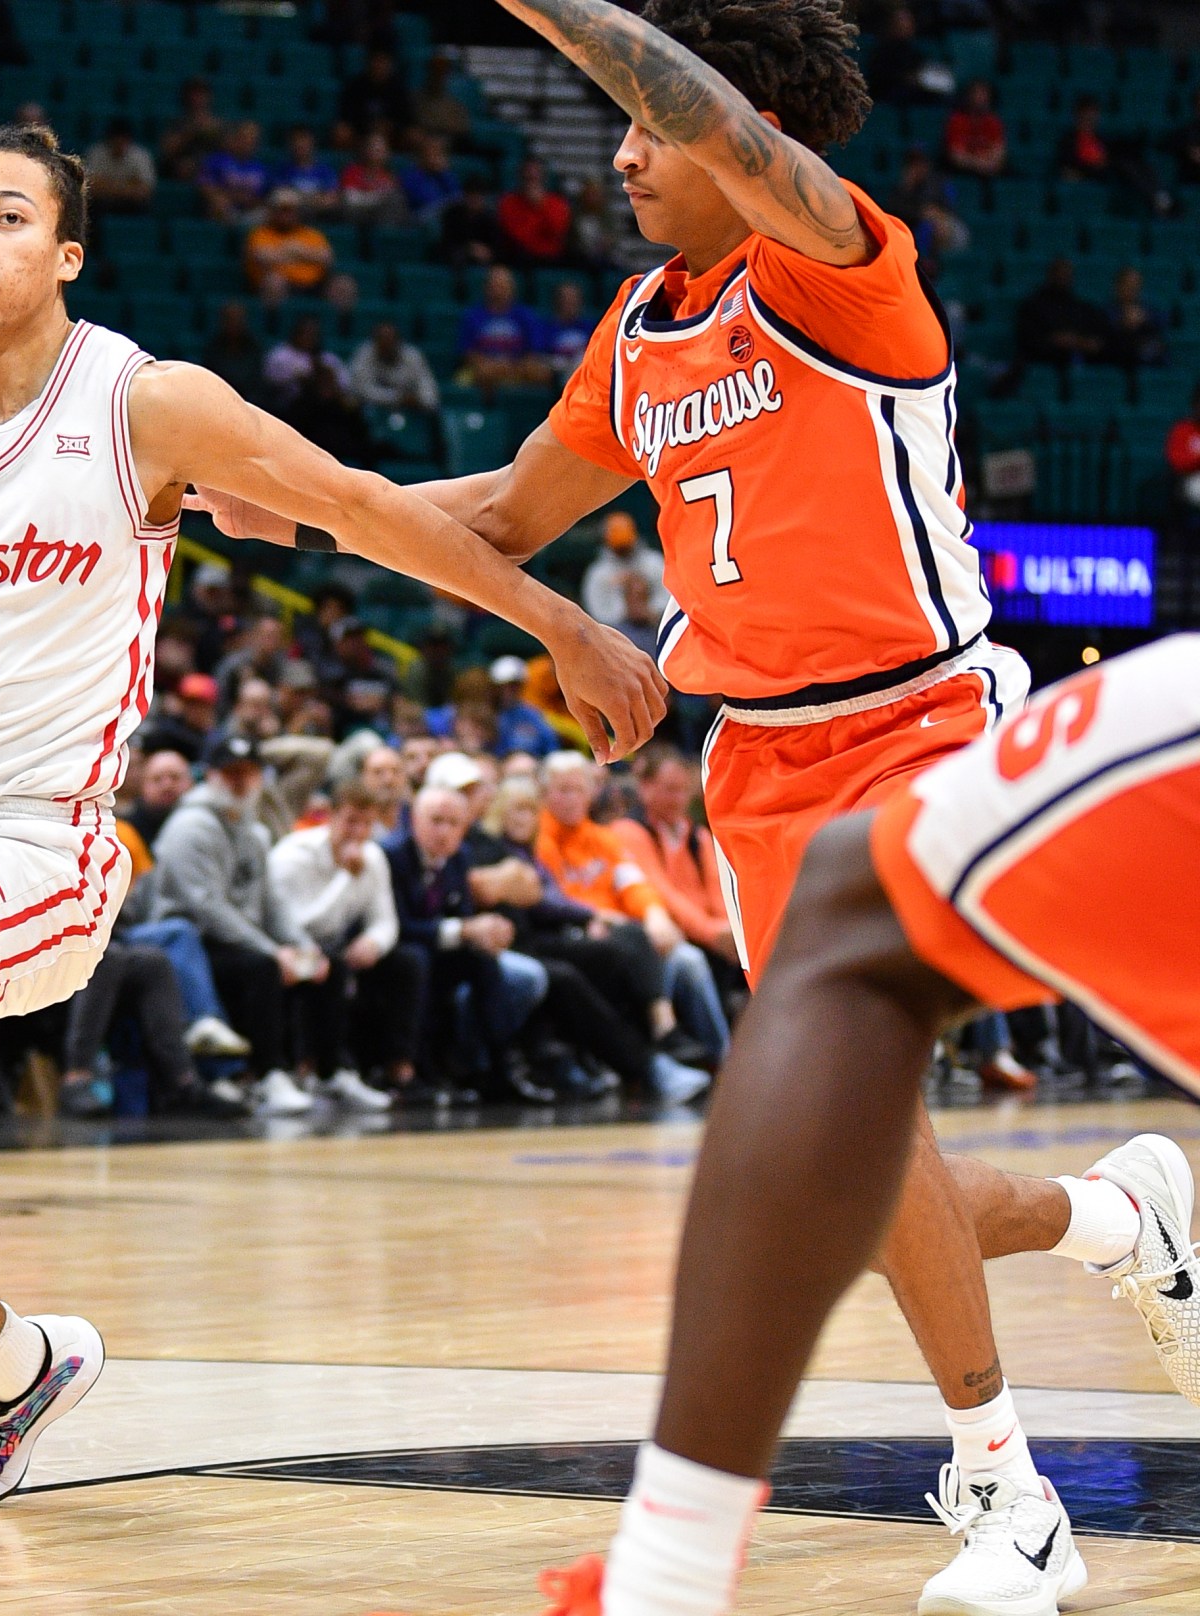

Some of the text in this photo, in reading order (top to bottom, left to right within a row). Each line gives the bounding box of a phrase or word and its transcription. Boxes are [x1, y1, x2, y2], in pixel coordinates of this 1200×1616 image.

[631, 359, 783, 478] Syracuse
[676, 466, 744, 587] 7
[1023, 555, 1152, 597] ULTRA
